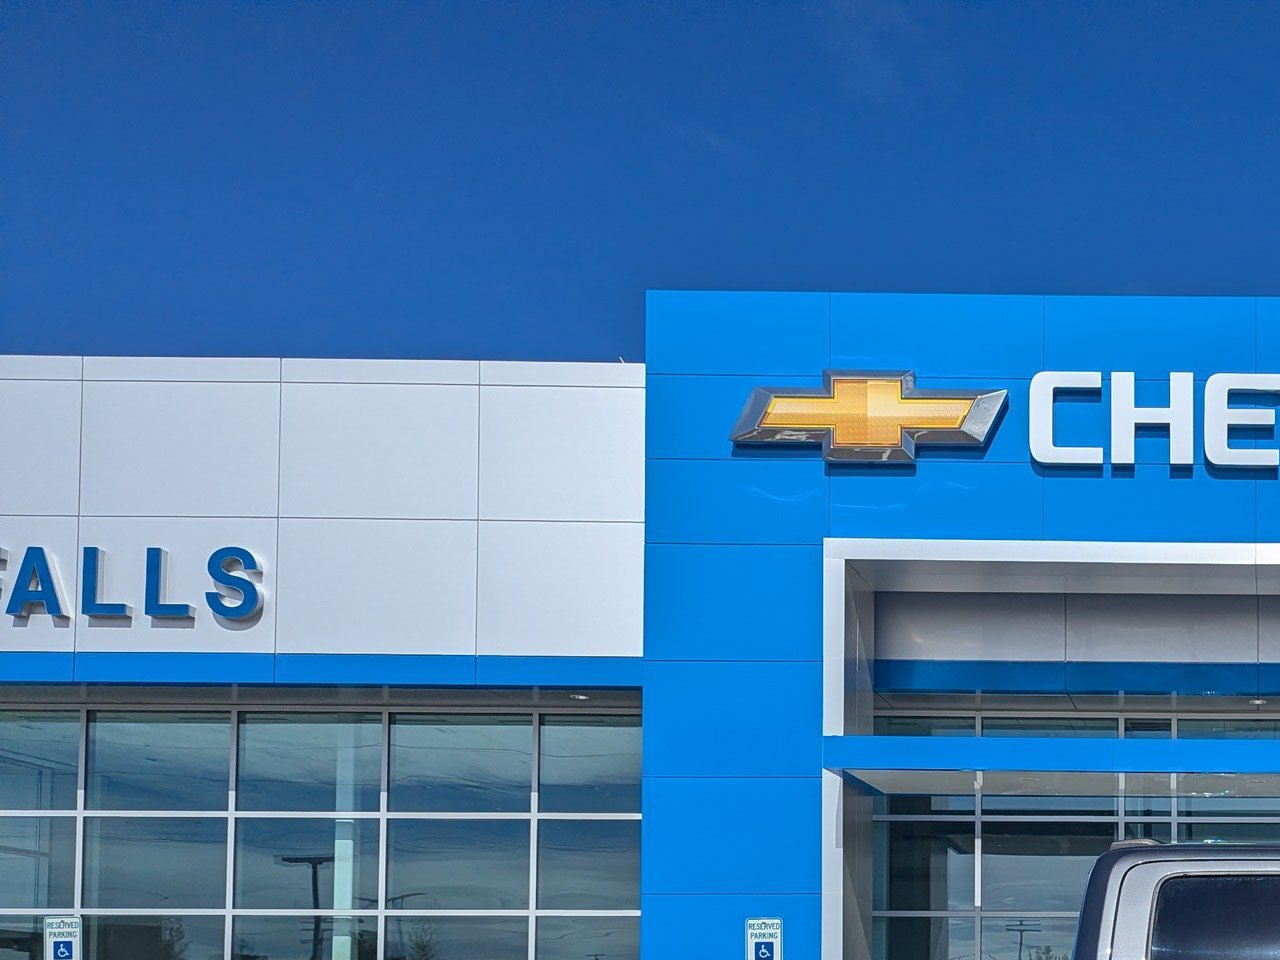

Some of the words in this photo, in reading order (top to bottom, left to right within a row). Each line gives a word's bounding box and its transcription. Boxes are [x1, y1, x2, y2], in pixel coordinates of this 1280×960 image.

[0, 546, 265, 620] ALLS
[47, 921, 79, 929] RESERVED
[749, 922, 780, 930] RESERVED
[49, 931, 77, 939] PARKING
